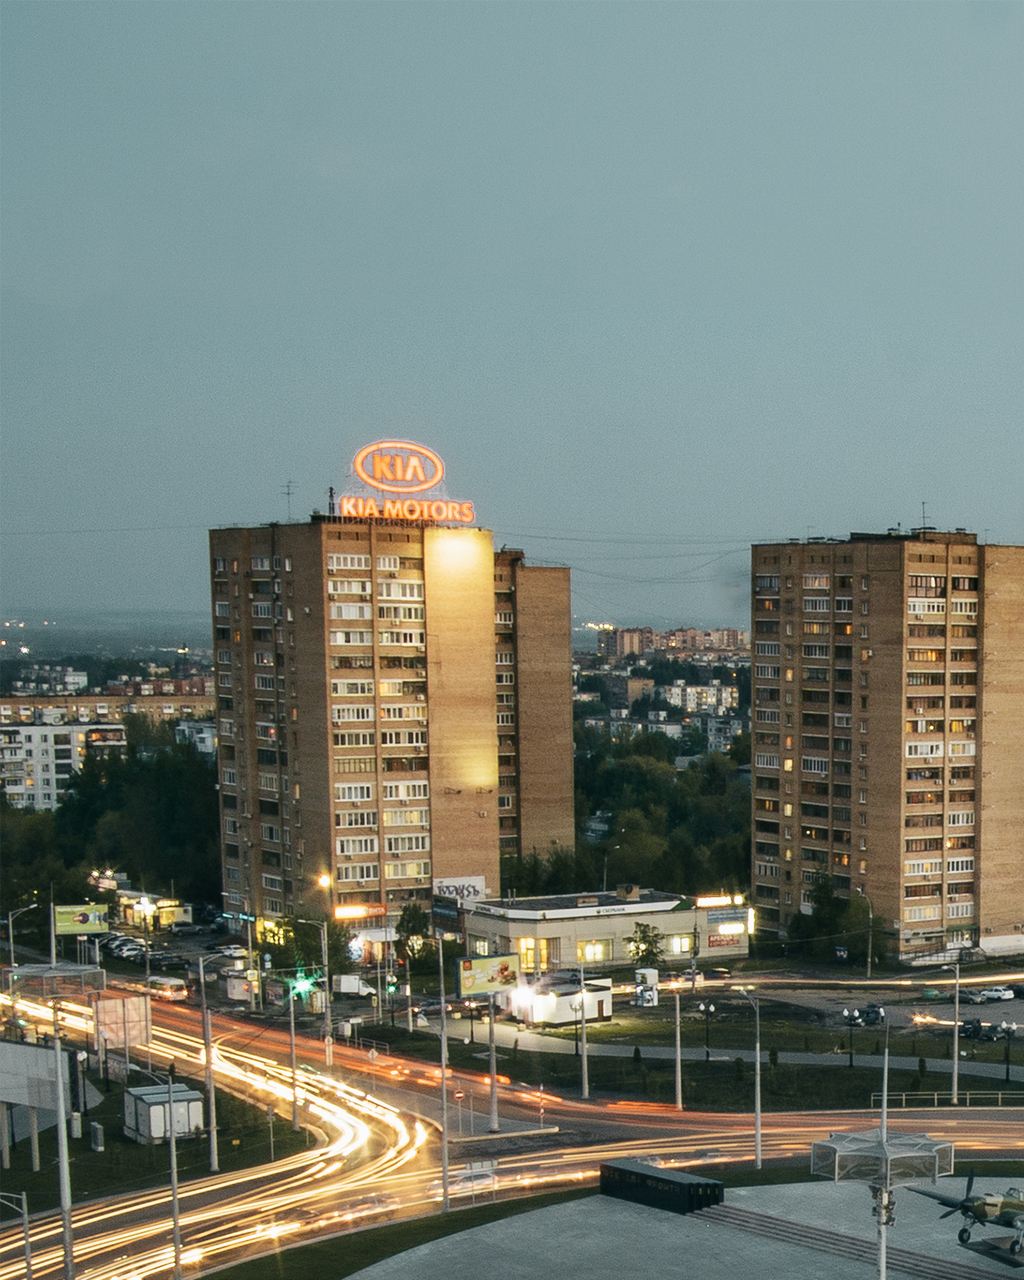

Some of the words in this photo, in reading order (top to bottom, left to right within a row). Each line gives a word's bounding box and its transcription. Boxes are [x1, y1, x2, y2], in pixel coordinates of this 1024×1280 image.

[373, 454, 426, 482] KIA
[341, 497, 380, 518] KIA
[383, 500, 475, 524] MOTORS
